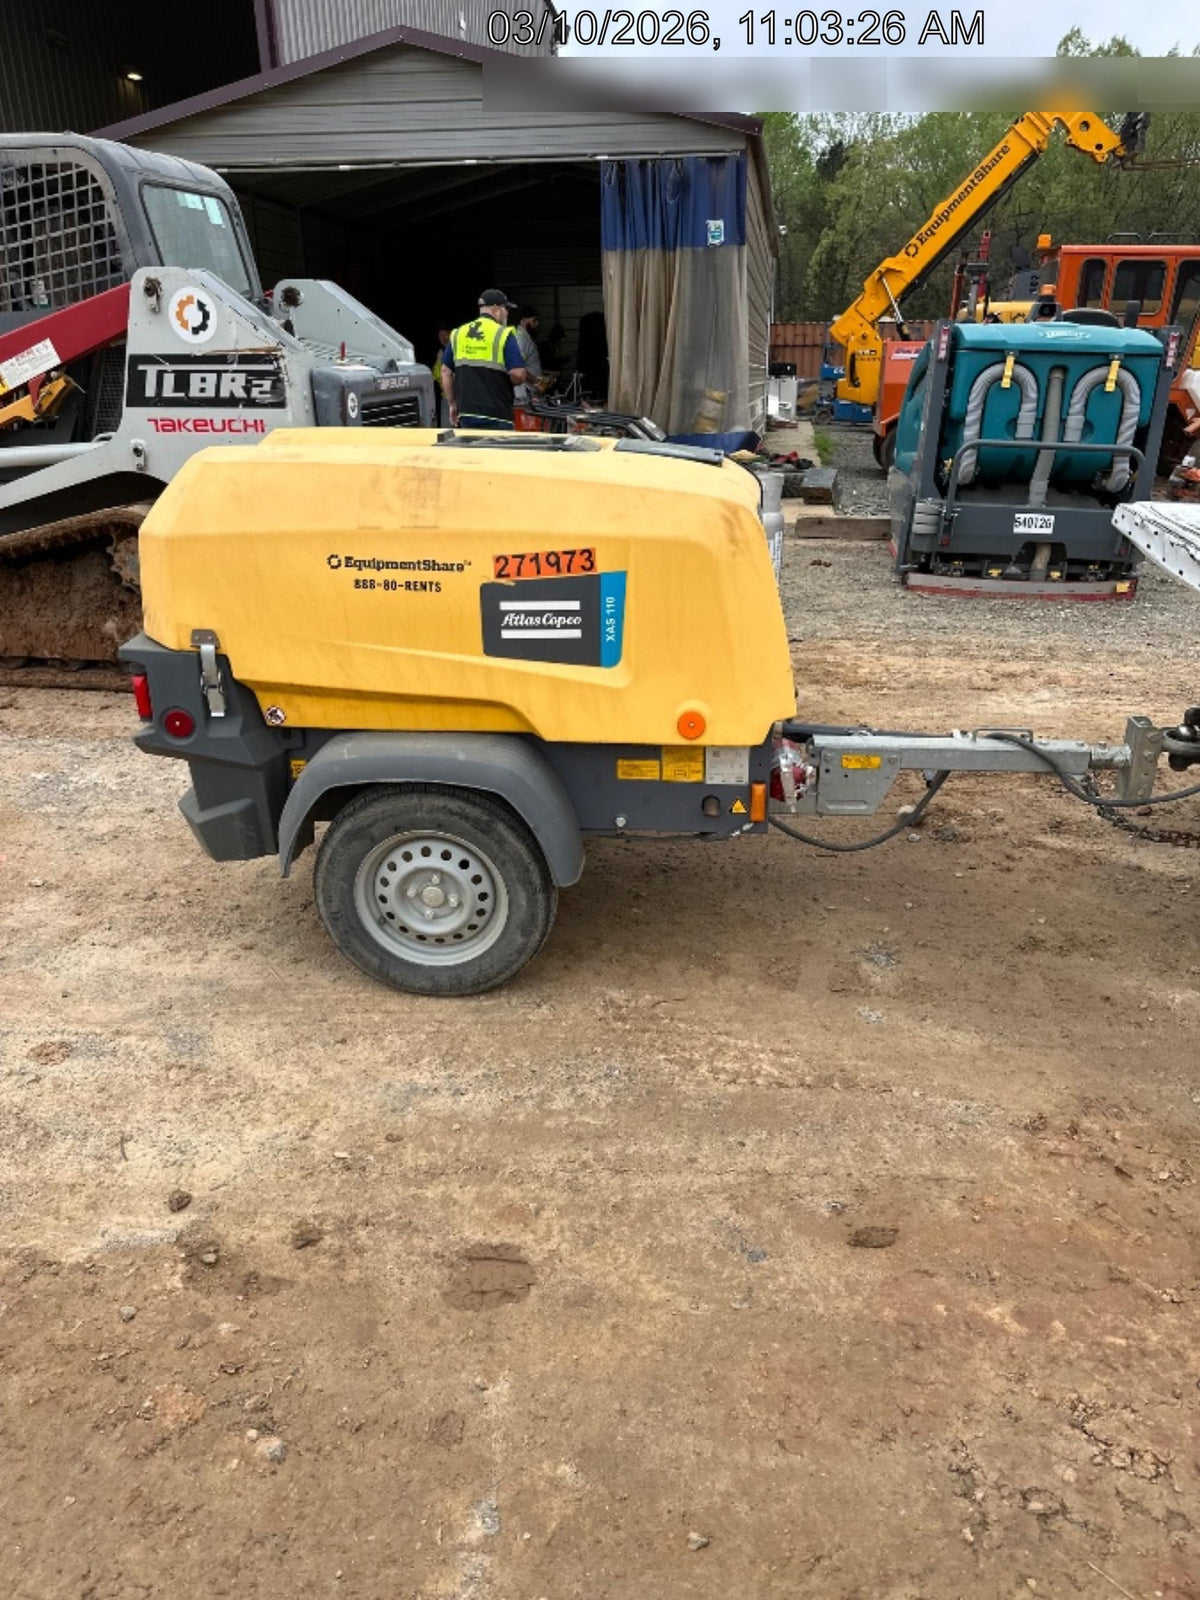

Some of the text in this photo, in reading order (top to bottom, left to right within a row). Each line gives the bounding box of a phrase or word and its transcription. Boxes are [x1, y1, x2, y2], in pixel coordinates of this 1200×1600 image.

[917, 144, 1011, 246] EquipmentShare
[147, 418, 266, 433] TAKEUCHI
[495, 549, 595, 578] 271973
[354, 579, 442, 593] 888-80-RENTS
[501, 613, 582, 628] Atlas Copco
[605, 596, 616, 642] XAS 110
